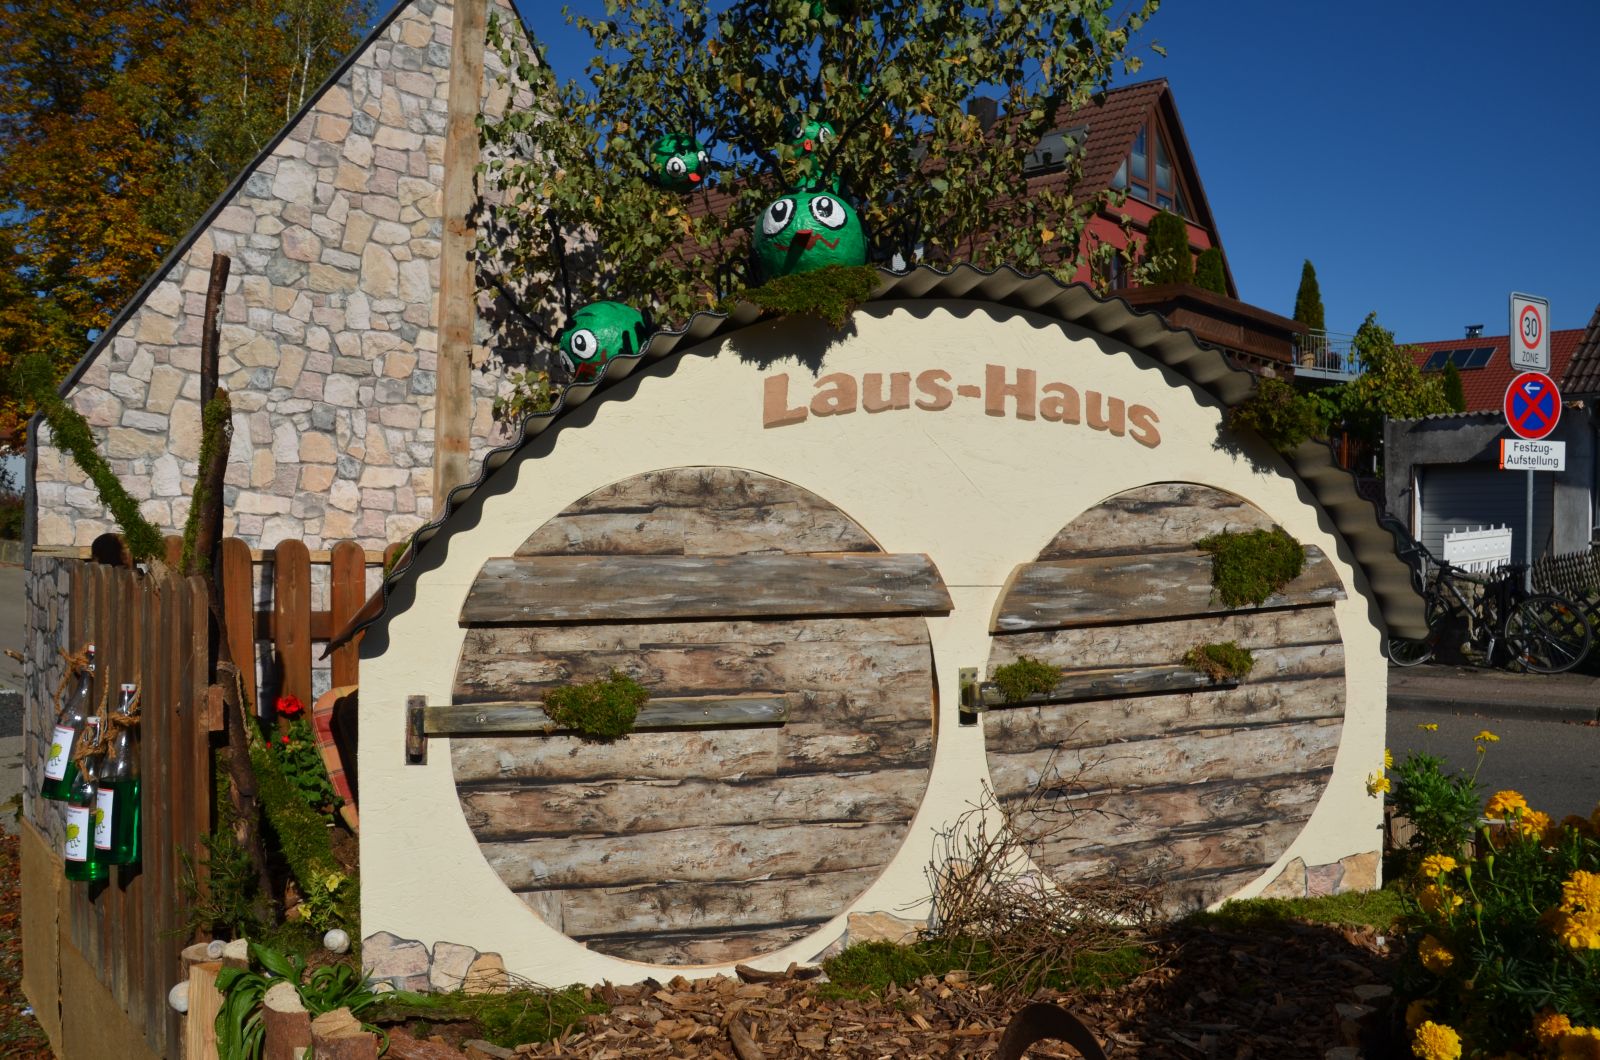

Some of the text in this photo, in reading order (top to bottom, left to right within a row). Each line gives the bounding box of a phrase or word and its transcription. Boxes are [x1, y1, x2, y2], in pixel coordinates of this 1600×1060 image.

[1524, 317, 1538, 338] 30
[1522, 351, 1539, 364] ZONE
[763, 363, 1161, 449] Laus-Haus
[1513, 441, 1553, 454] Festzug-
[1506, 454, 1559, 468] Aufstellung
